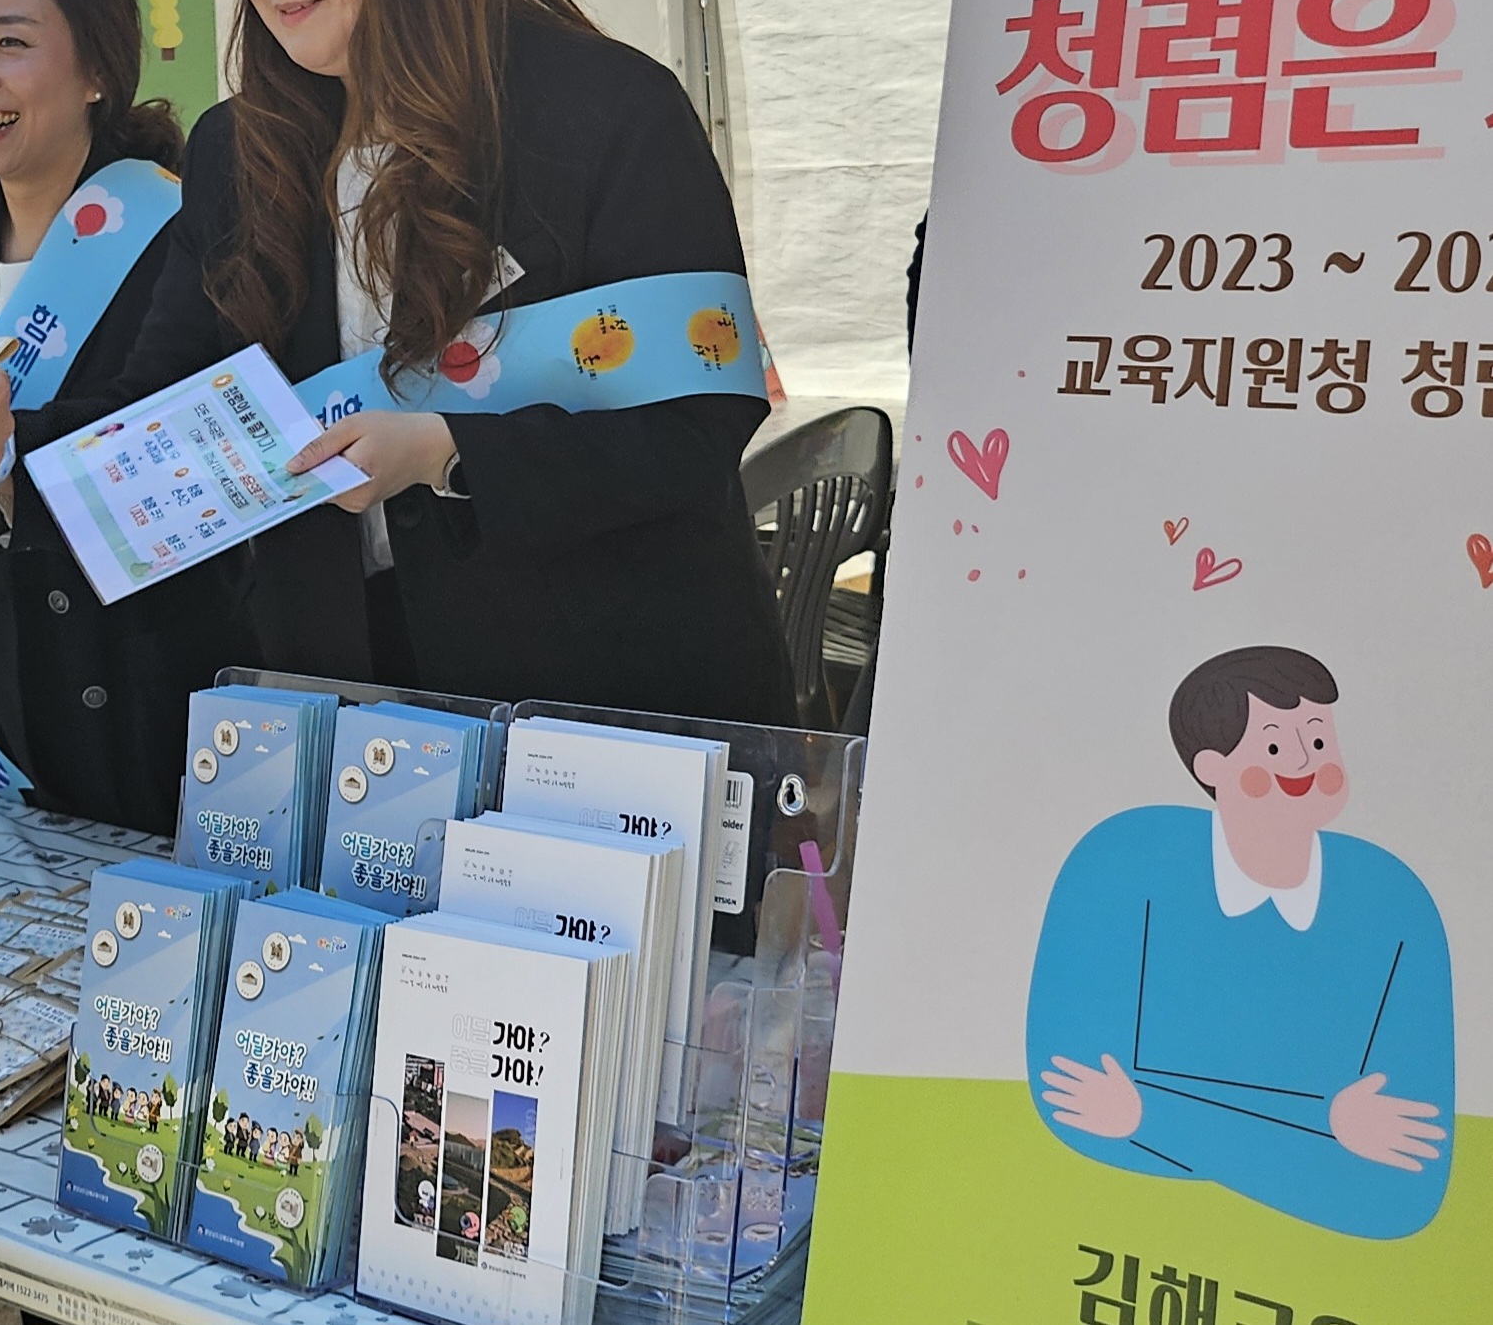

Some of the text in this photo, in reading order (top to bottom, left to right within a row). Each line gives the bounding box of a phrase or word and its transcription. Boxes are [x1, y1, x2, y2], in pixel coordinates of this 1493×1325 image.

[1140, 229, 1493, 294] 2023 ~ 20
[1056, 334, 1493, 419] 교육지원청 청
[197, 809, 260, 841] 어딜가야?
[207, 837, 272, 871] 좋을가야!!
[340, 831, 415, 866] 어딜가야?
[351, 862, 427, 900] 좋을가야!!
[94, 994, 161, 1030] 어딜가야?
[104, 1026, 172, 1063] 좋을가야!!
[234, 1028, 307, 1068] 어딜가야?
[243, 1060, 319, 1102] 좋을가야!!
